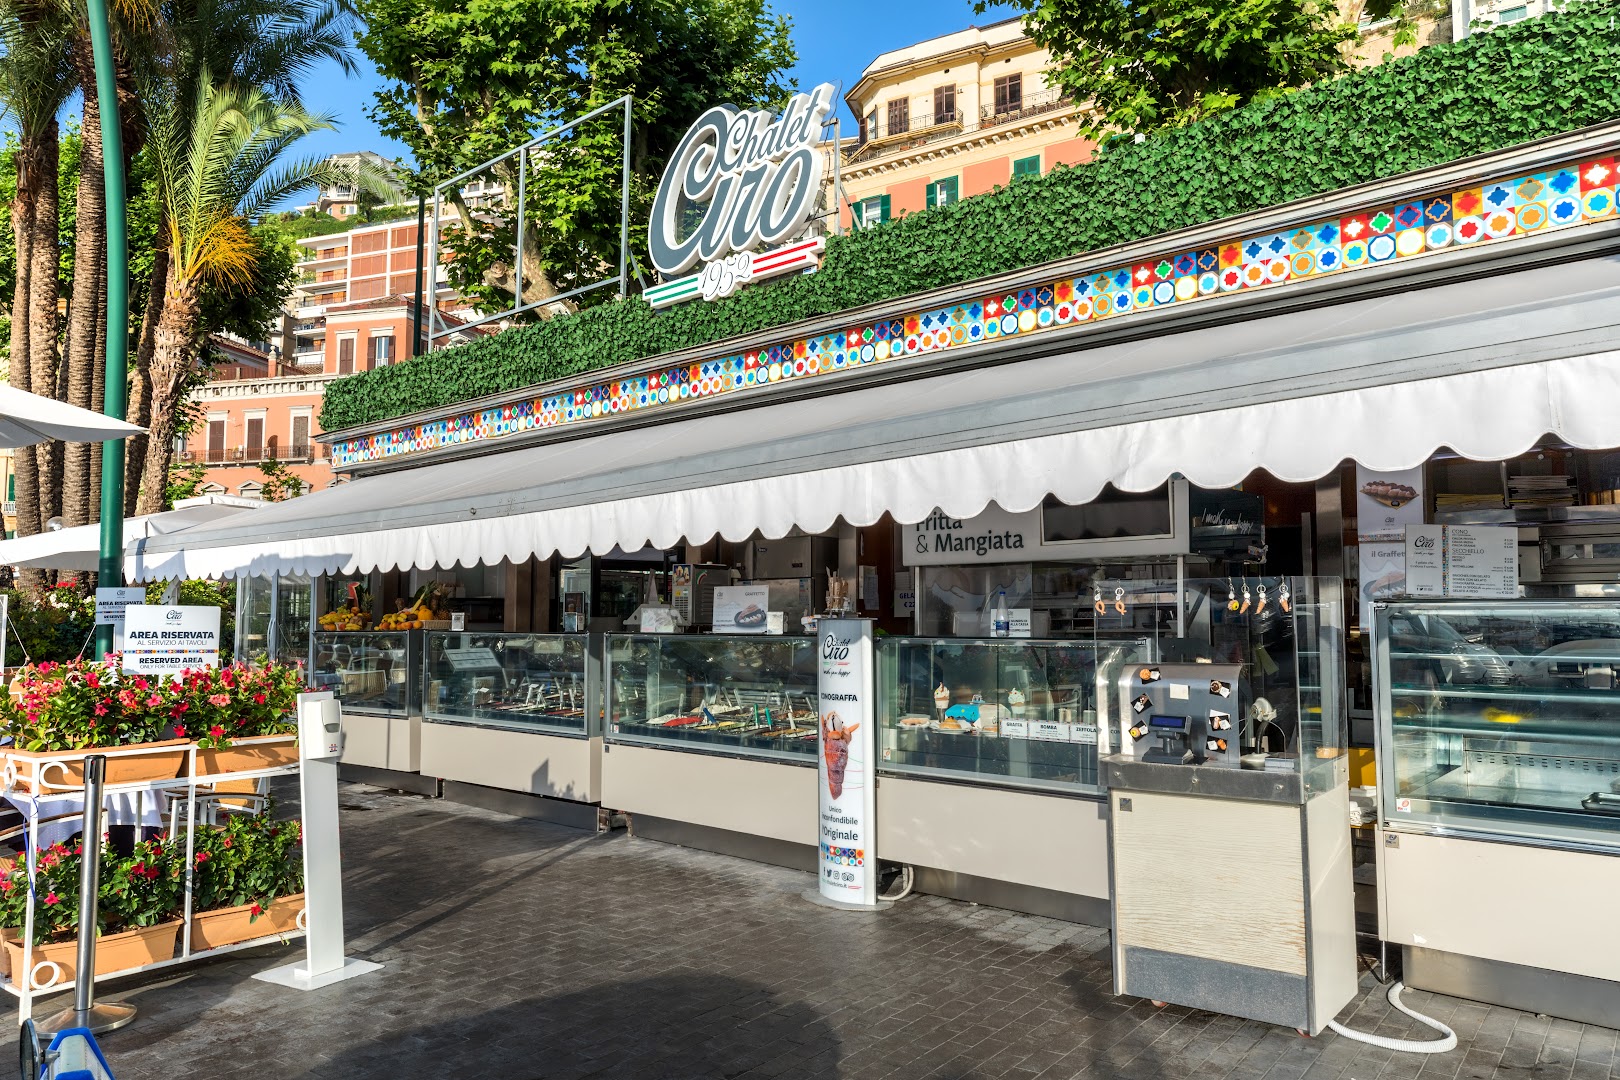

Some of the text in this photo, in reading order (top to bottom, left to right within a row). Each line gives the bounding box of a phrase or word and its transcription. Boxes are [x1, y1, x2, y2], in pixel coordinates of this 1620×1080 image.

[722, 88, 821, 171] Chalet
[649, 106, 813, 273] Ciro
[702, 253, 751, 298] 1952
[916, 530, 1024, 556] & Mangiata
[823, 634, 849, 660] Ciro
